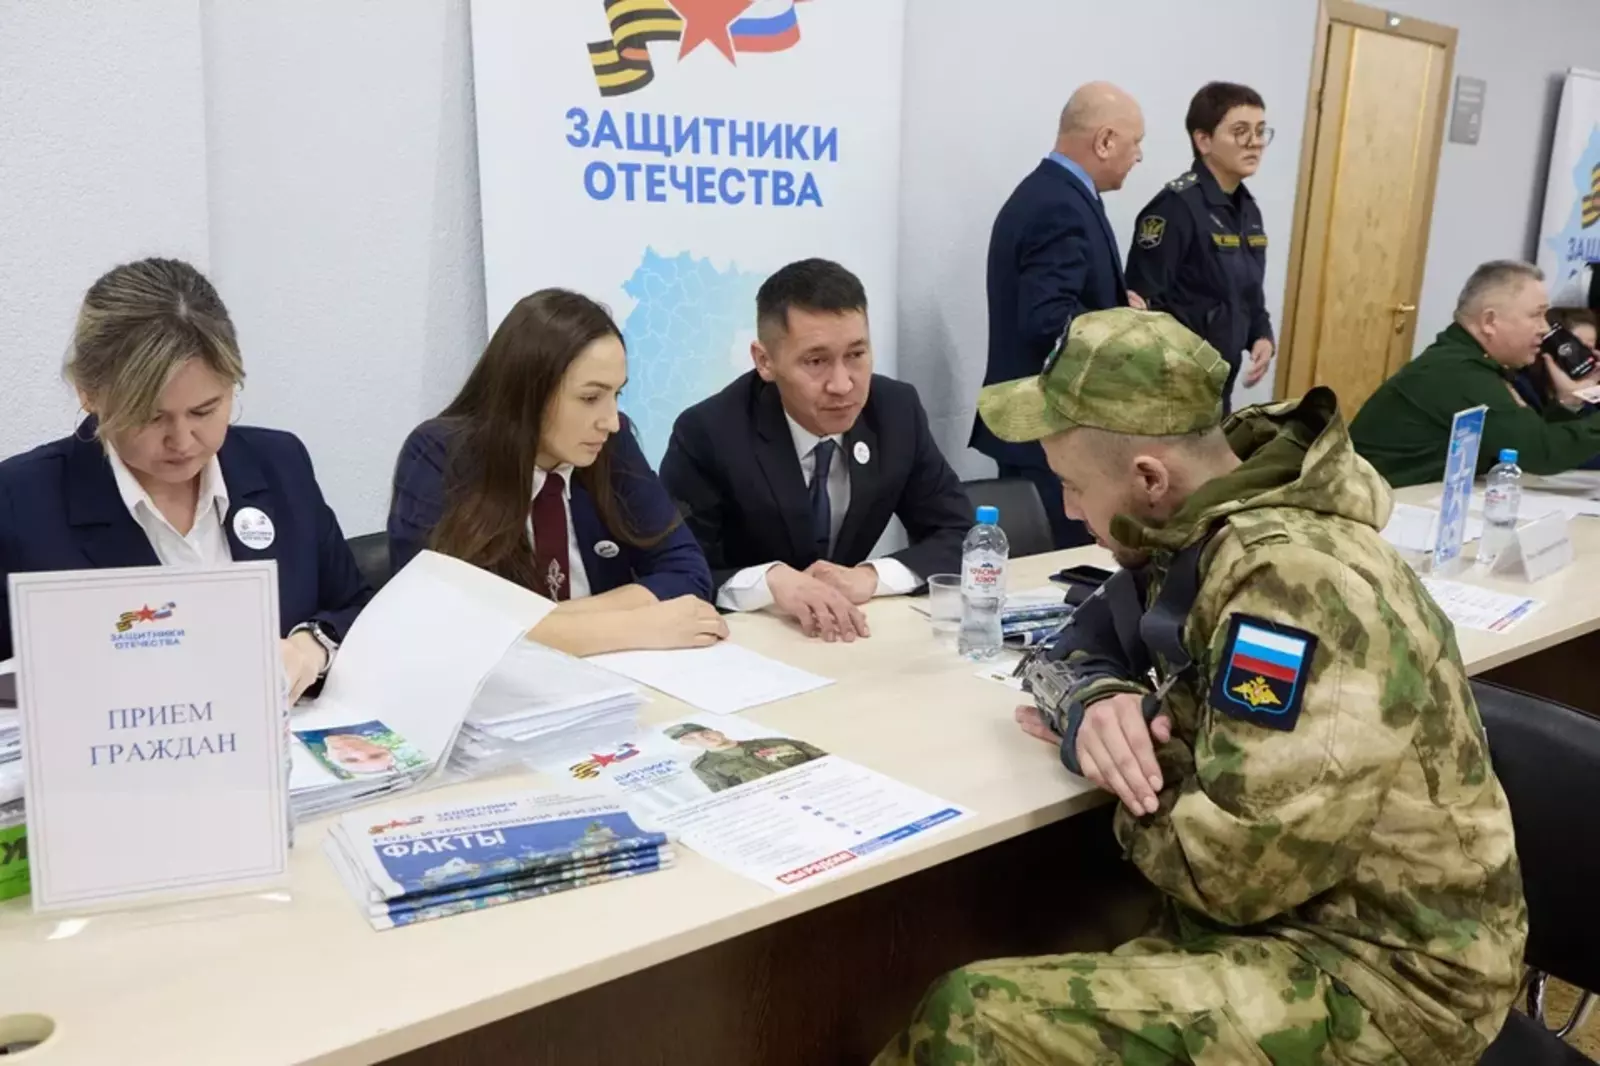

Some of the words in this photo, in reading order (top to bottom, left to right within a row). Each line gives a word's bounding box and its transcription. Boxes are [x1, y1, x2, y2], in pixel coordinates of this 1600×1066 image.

[565, 107, 838, 162] ЗАЩИТНИКИ
[583, 161, 824, 207] ОТЕЧЕСТВА
[110, 629, 185, 642] ЗАЩИТНИКИ
[114, 638, 181, 650] ОТЕЧЕСТВА
[107, 701, 214, 731] ПРИЕМ
[89, 732, 238, 768] ГРАЖДАН
[382, 830, 507, 858] ФАКТЫ
